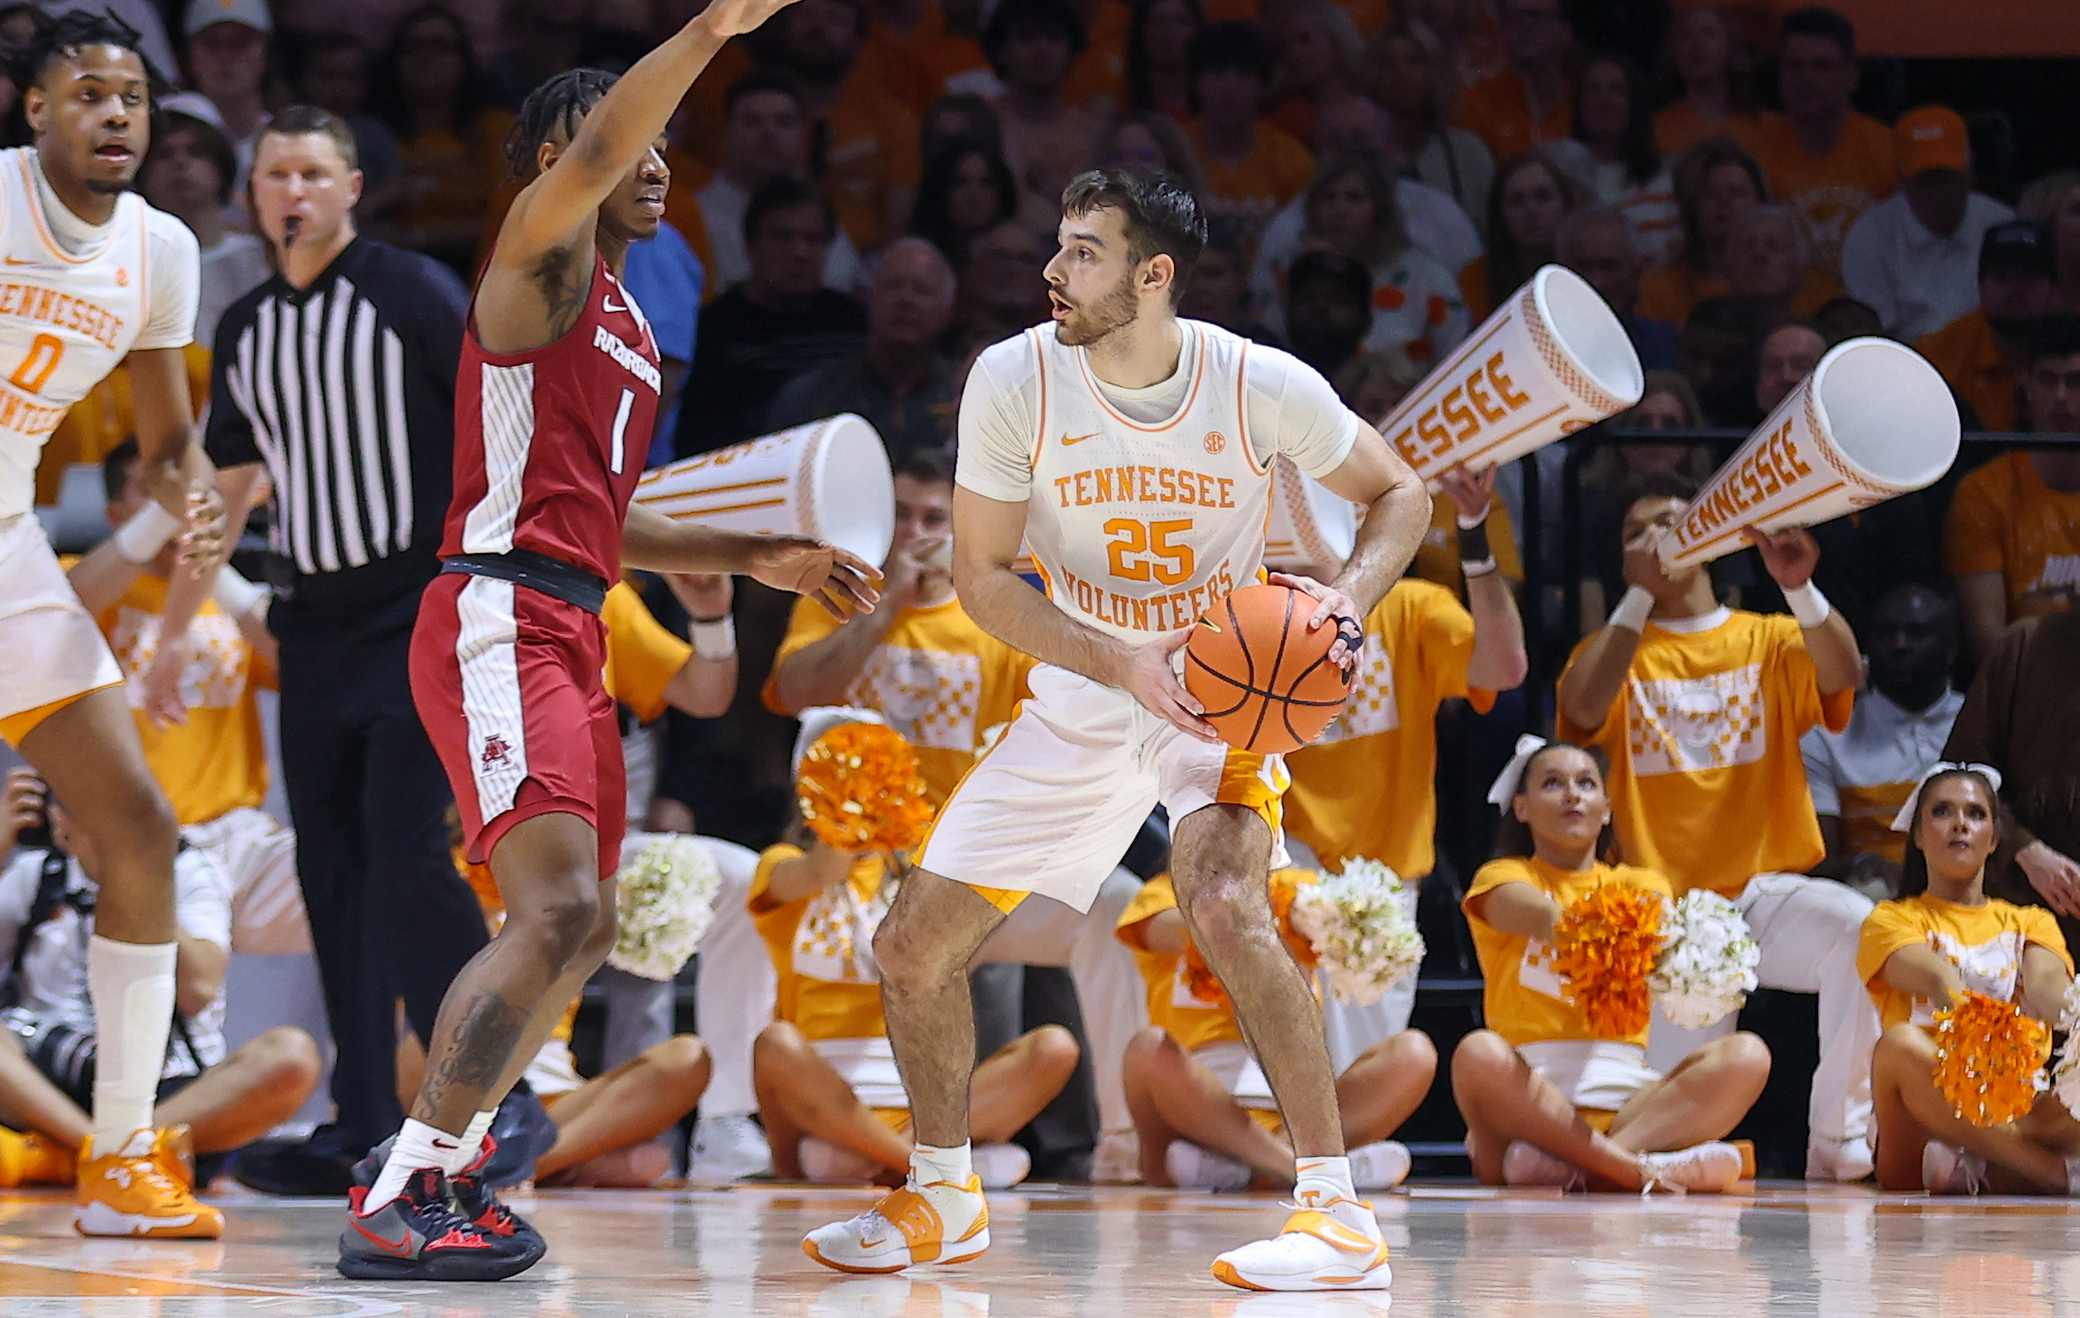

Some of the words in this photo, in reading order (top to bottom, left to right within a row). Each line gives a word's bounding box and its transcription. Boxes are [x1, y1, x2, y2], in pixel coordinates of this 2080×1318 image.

[0, 283, 123, 350] ENNESSEE
[9, 333, 65, 394] 0
[610, 386, 636, 475] 1
[1205, 433, 1225, 453] SEC
[1394, 350, 1532, 470] ESSEE
[1054, 466, 1235, 508] TENNESSEE
[1675, 417, 1813, 547] TENNESSEE
[1103, 518, 1194, 586] 25
[1061, 559, 1233, 632] VOLUNTEERS
